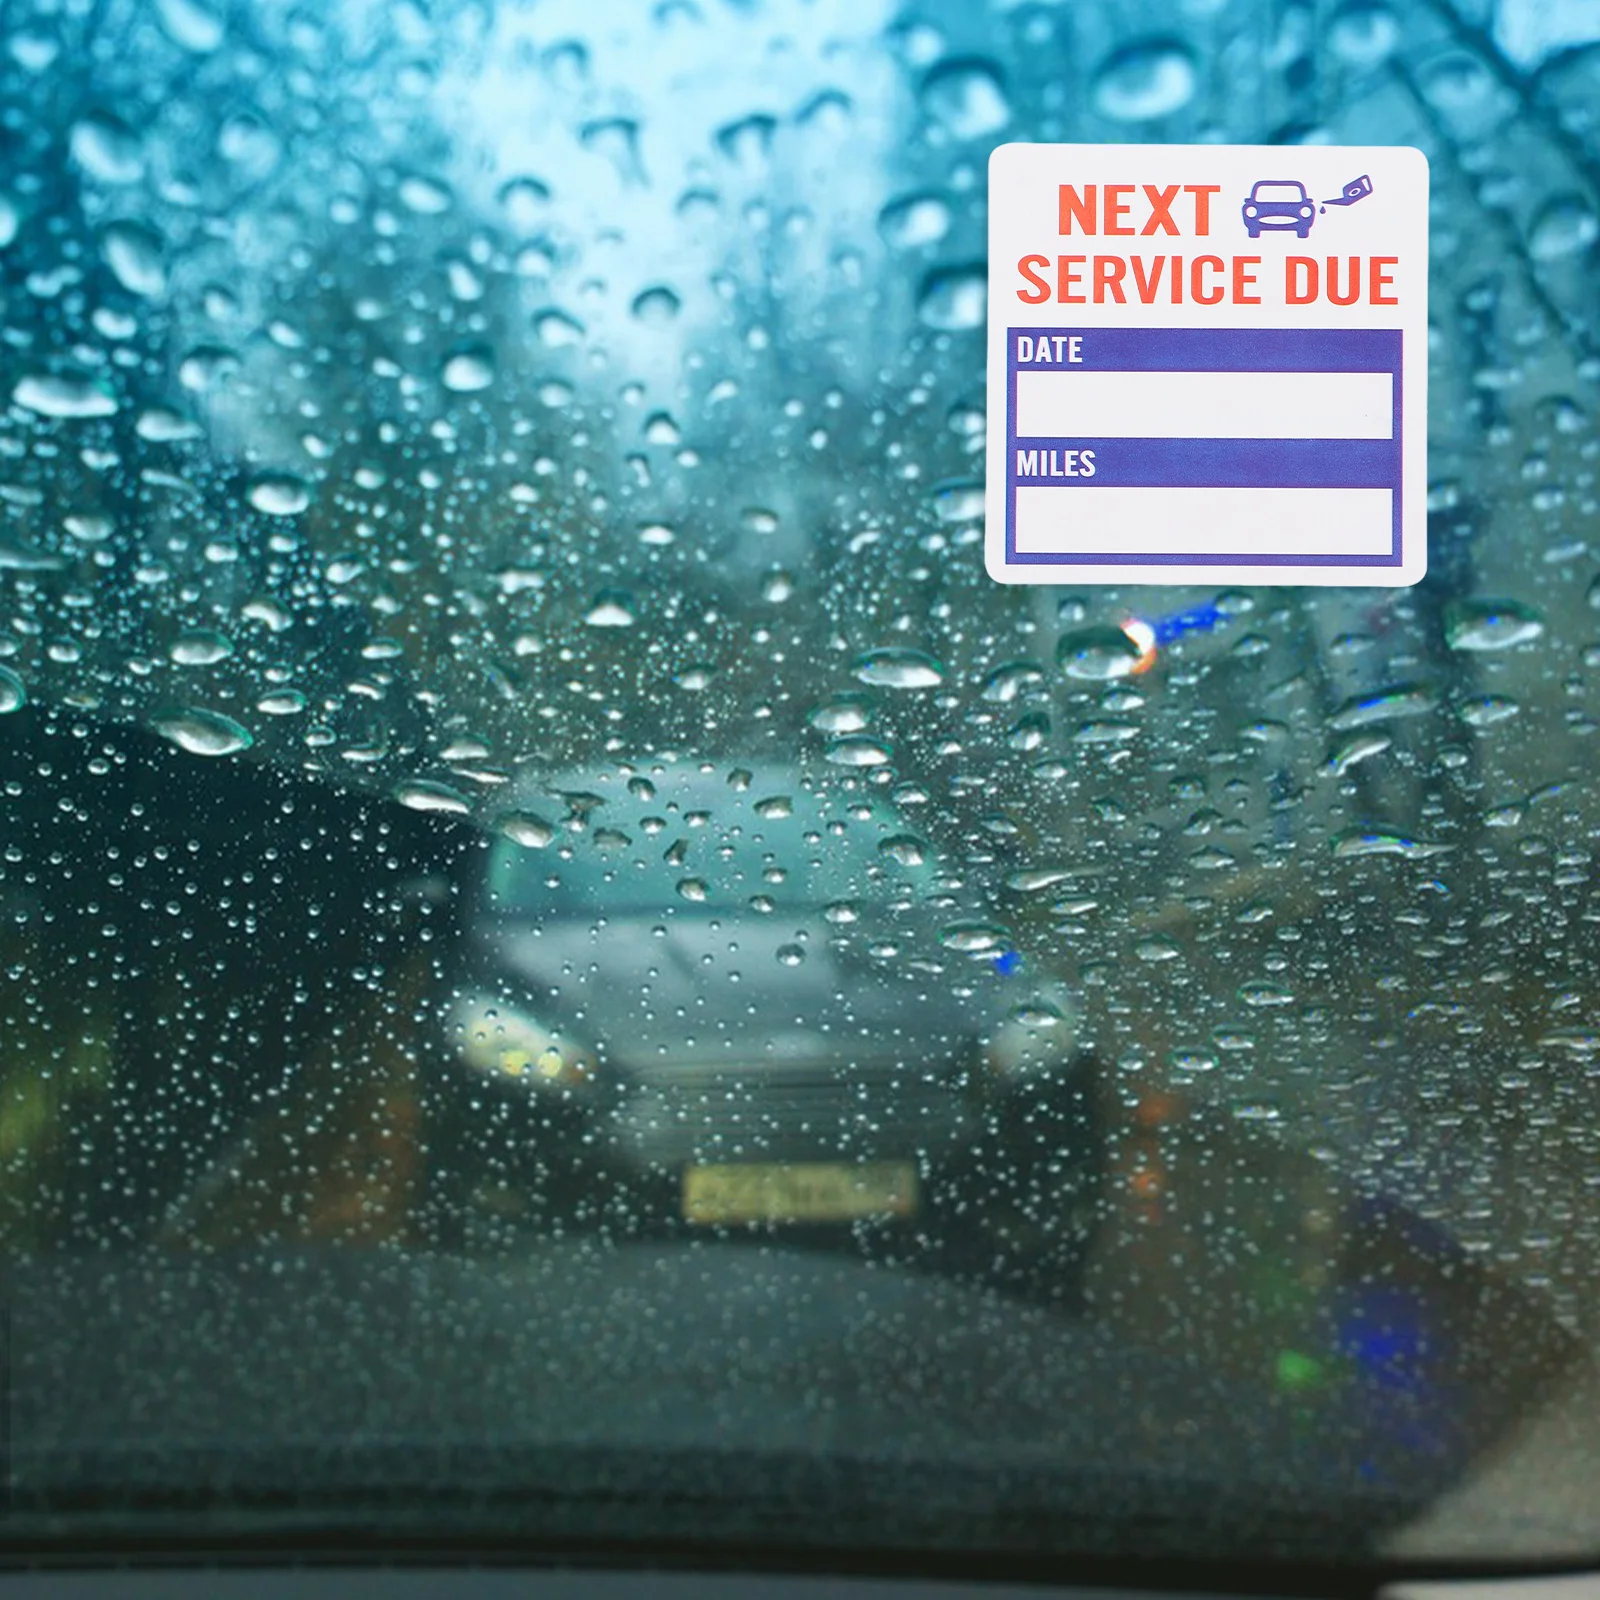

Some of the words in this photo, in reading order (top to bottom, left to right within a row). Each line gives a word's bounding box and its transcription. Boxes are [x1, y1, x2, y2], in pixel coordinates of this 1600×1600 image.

[1058, 184, 1221, 236] NEXT
[1016, 254, 1262, 305] SERVICE
[1285, 256, 1399, 306] DUE
[1017, 336, 1083, 363] DATE
[1017, 449, 1096, 477] MILES
